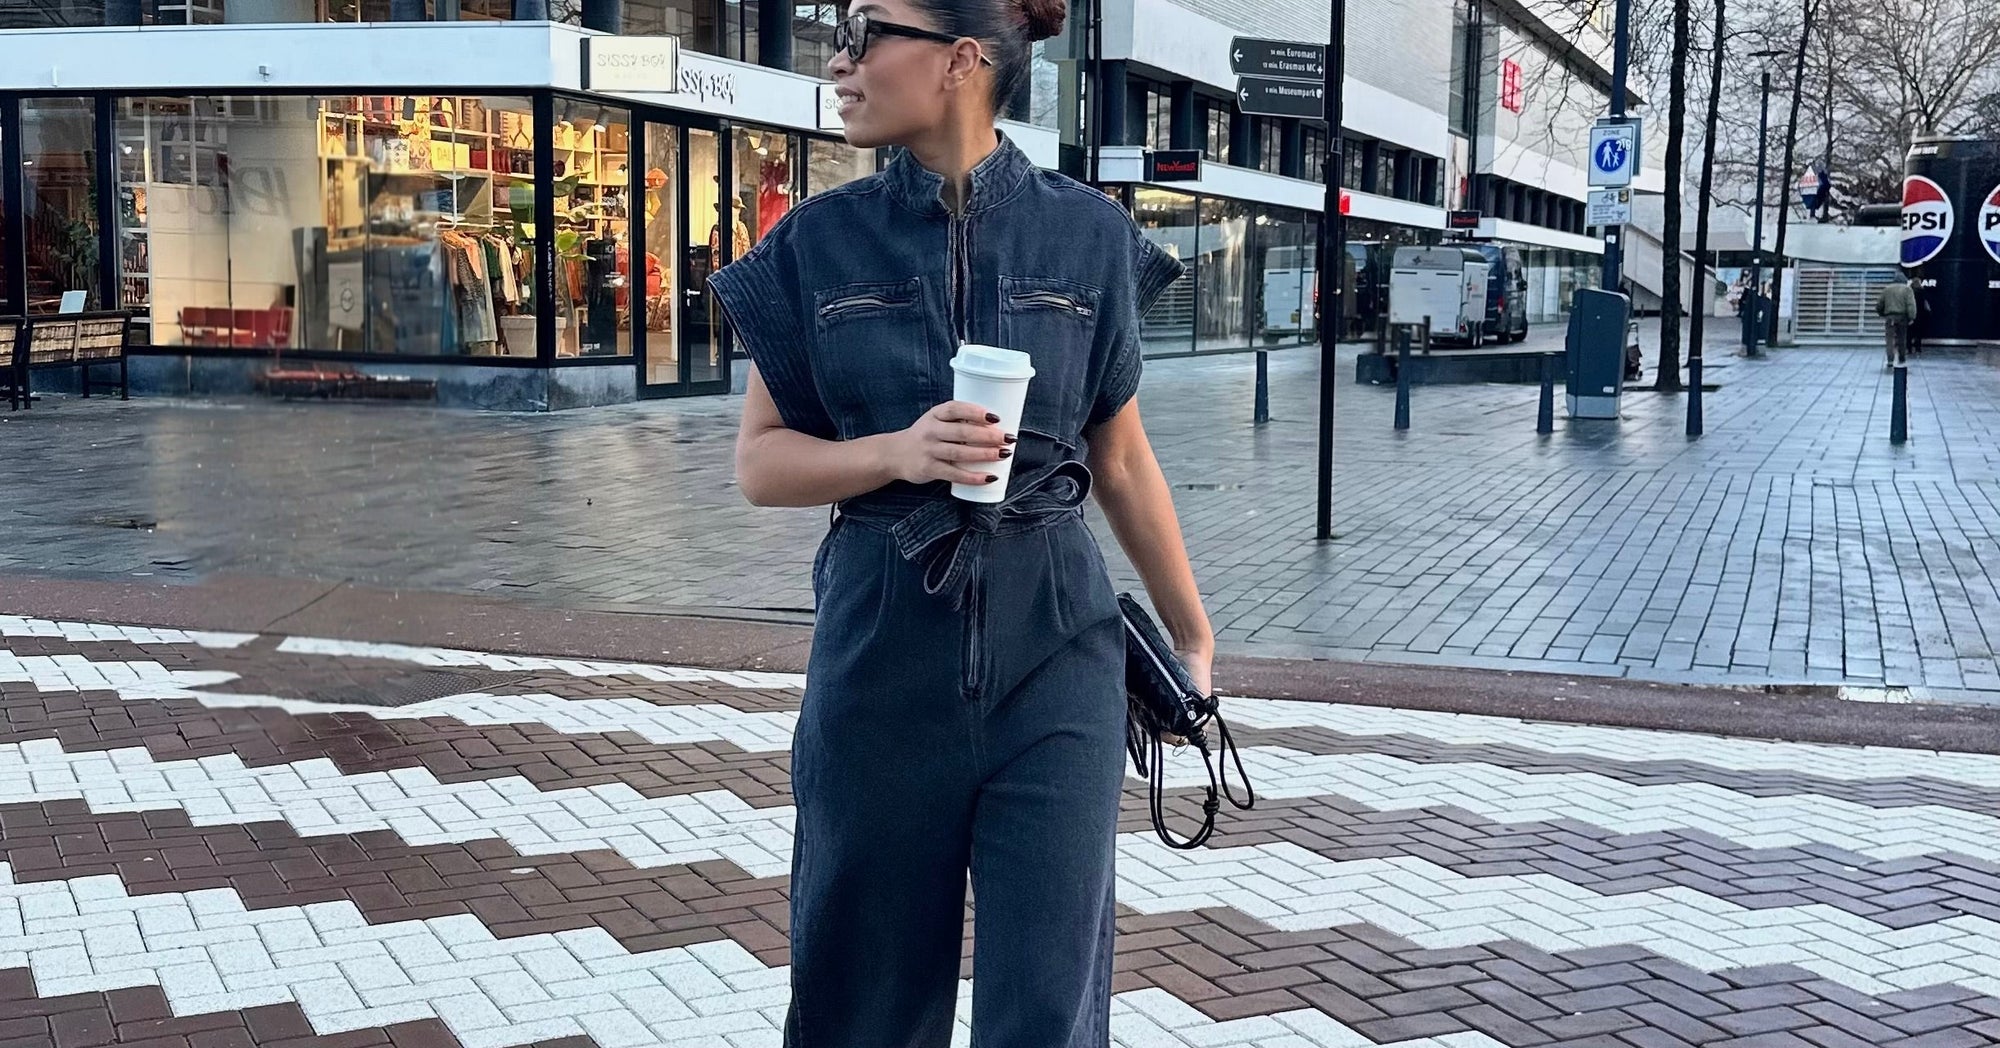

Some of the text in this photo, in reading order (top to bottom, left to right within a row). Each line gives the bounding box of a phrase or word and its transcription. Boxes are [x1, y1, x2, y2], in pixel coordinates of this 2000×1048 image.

[1287, 48, 1316, 59] Euromast
[1279, 61, 1305, 71] Erasmus
[1306, 63, 1316, 72] MC
[1278, 86, 1315, 98] Museumpark
[1902, 211, 1947, 231] EPSI
[1985, 212, 2000, 231] P
